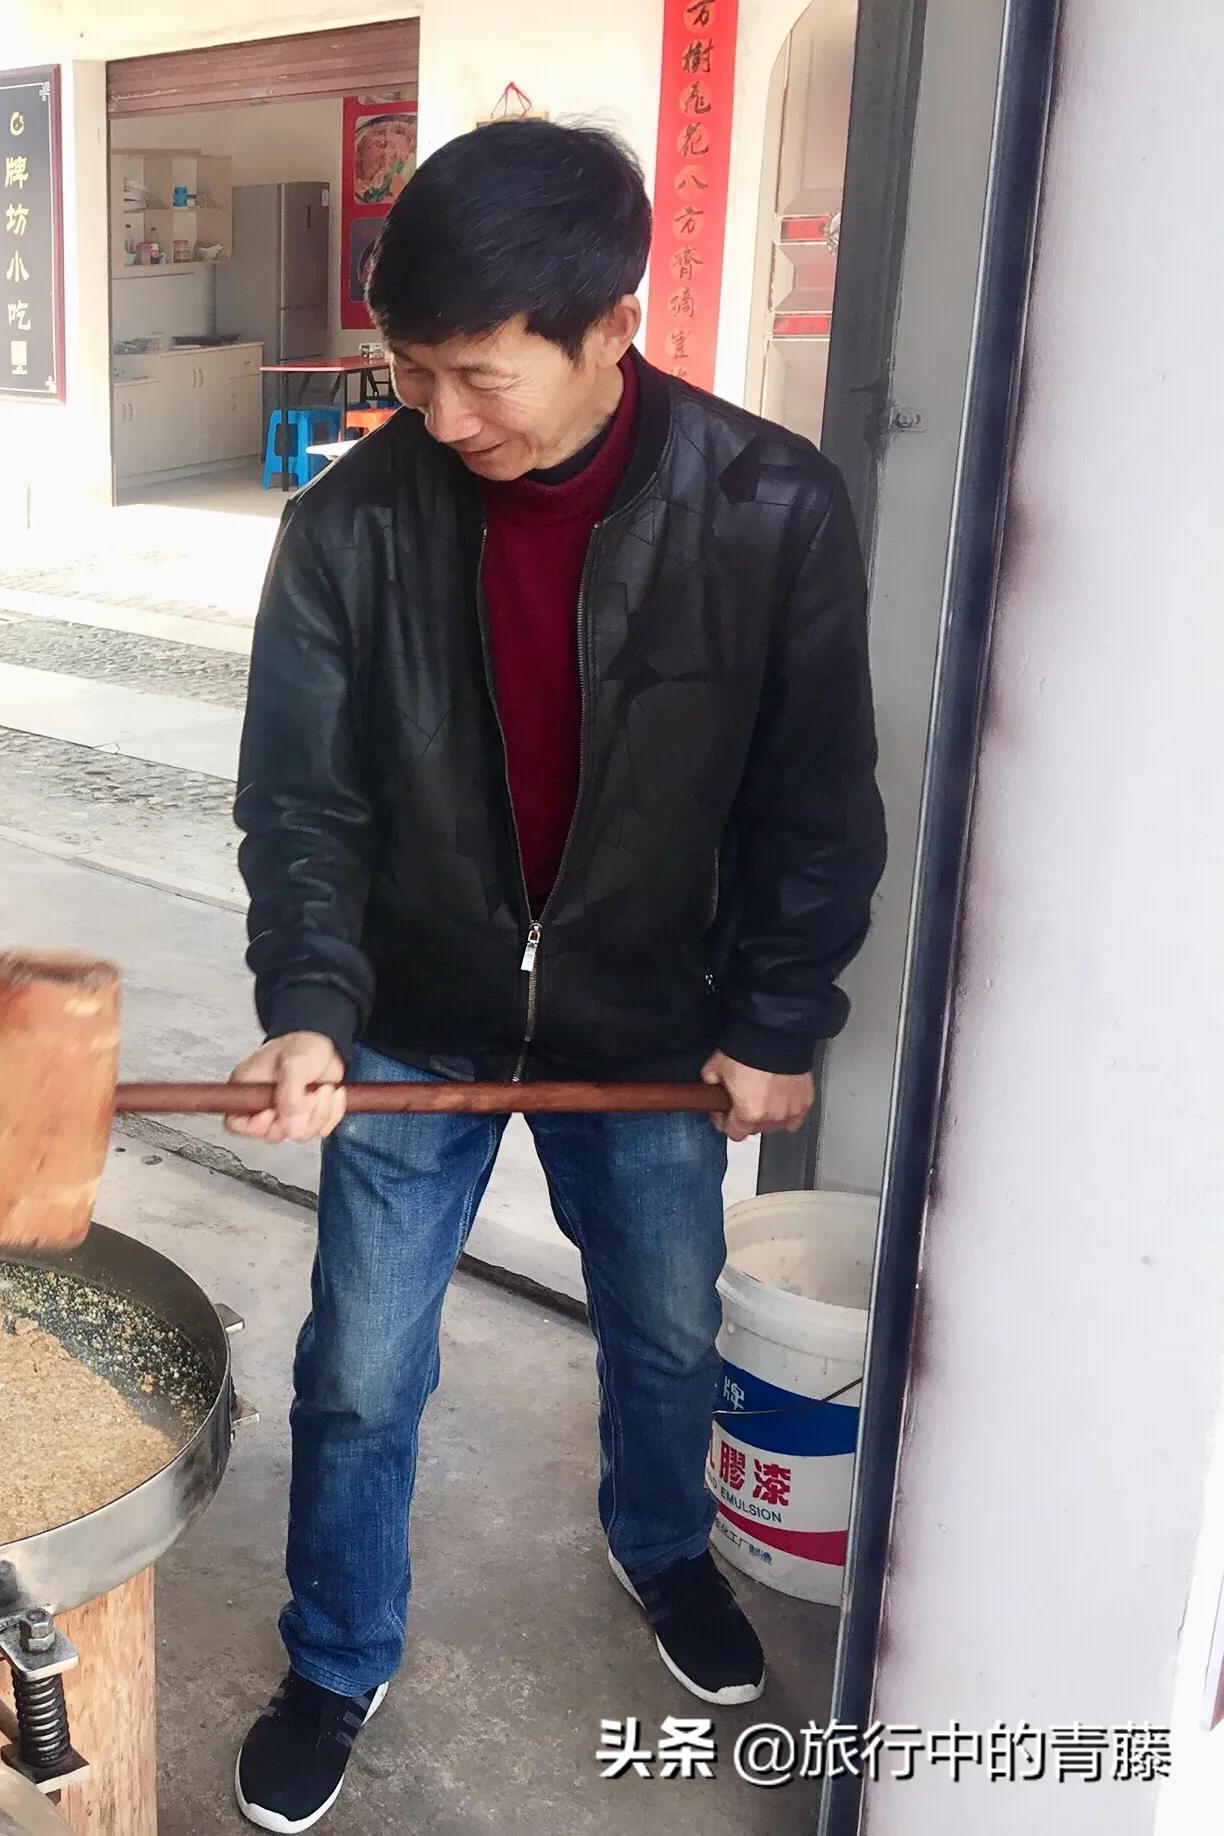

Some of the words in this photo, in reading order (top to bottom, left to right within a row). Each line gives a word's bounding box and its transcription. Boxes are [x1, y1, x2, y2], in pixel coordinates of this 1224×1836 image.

[5, 156, 32, 331] 牌坊小吃
[714, 1376, 745, 1411] 牌
[720, 1485, 782, 1524] EMULSION
